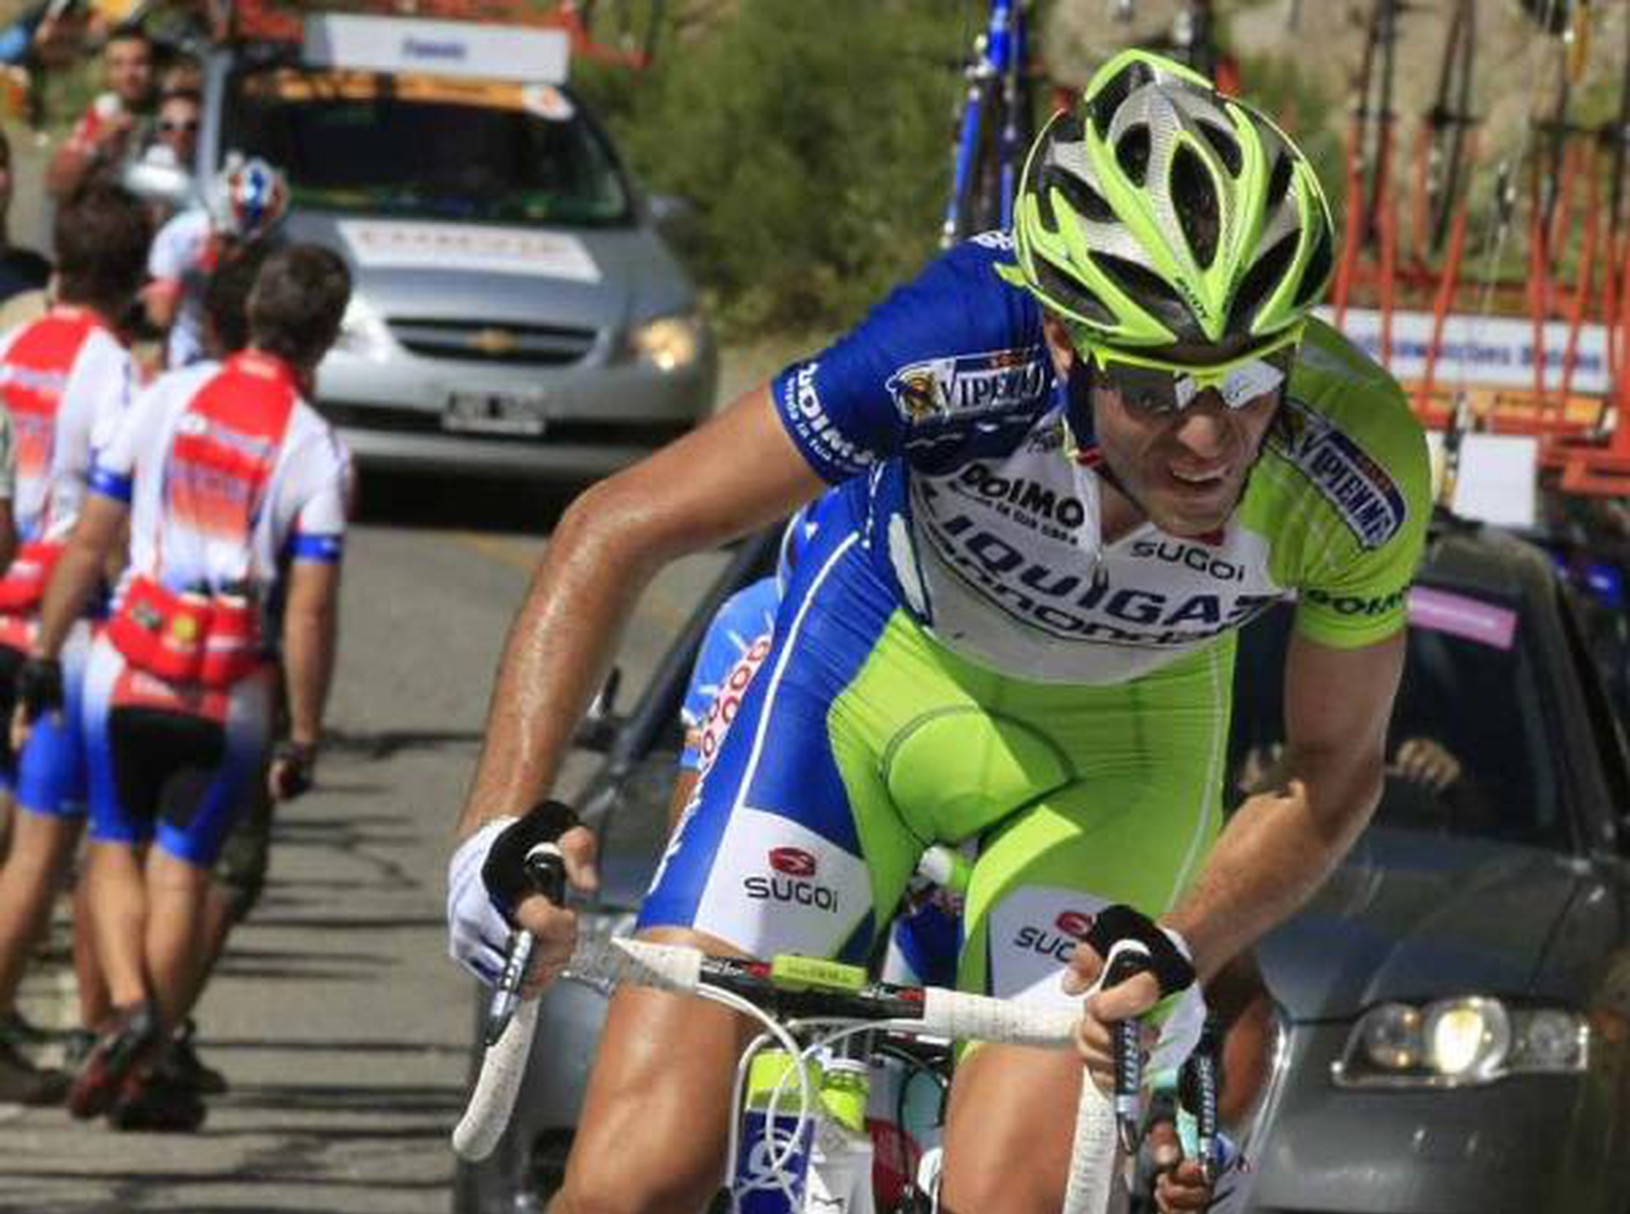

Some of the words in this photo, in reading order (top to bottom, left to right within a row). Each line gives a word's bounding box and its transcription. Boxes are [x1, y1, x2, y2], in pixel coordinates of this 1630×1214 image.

[960, 462, 1085, 529] DOIMO
[922, 481, 1283, 627] IQUIGA
[1013, 926, 1077, 964] SUG
